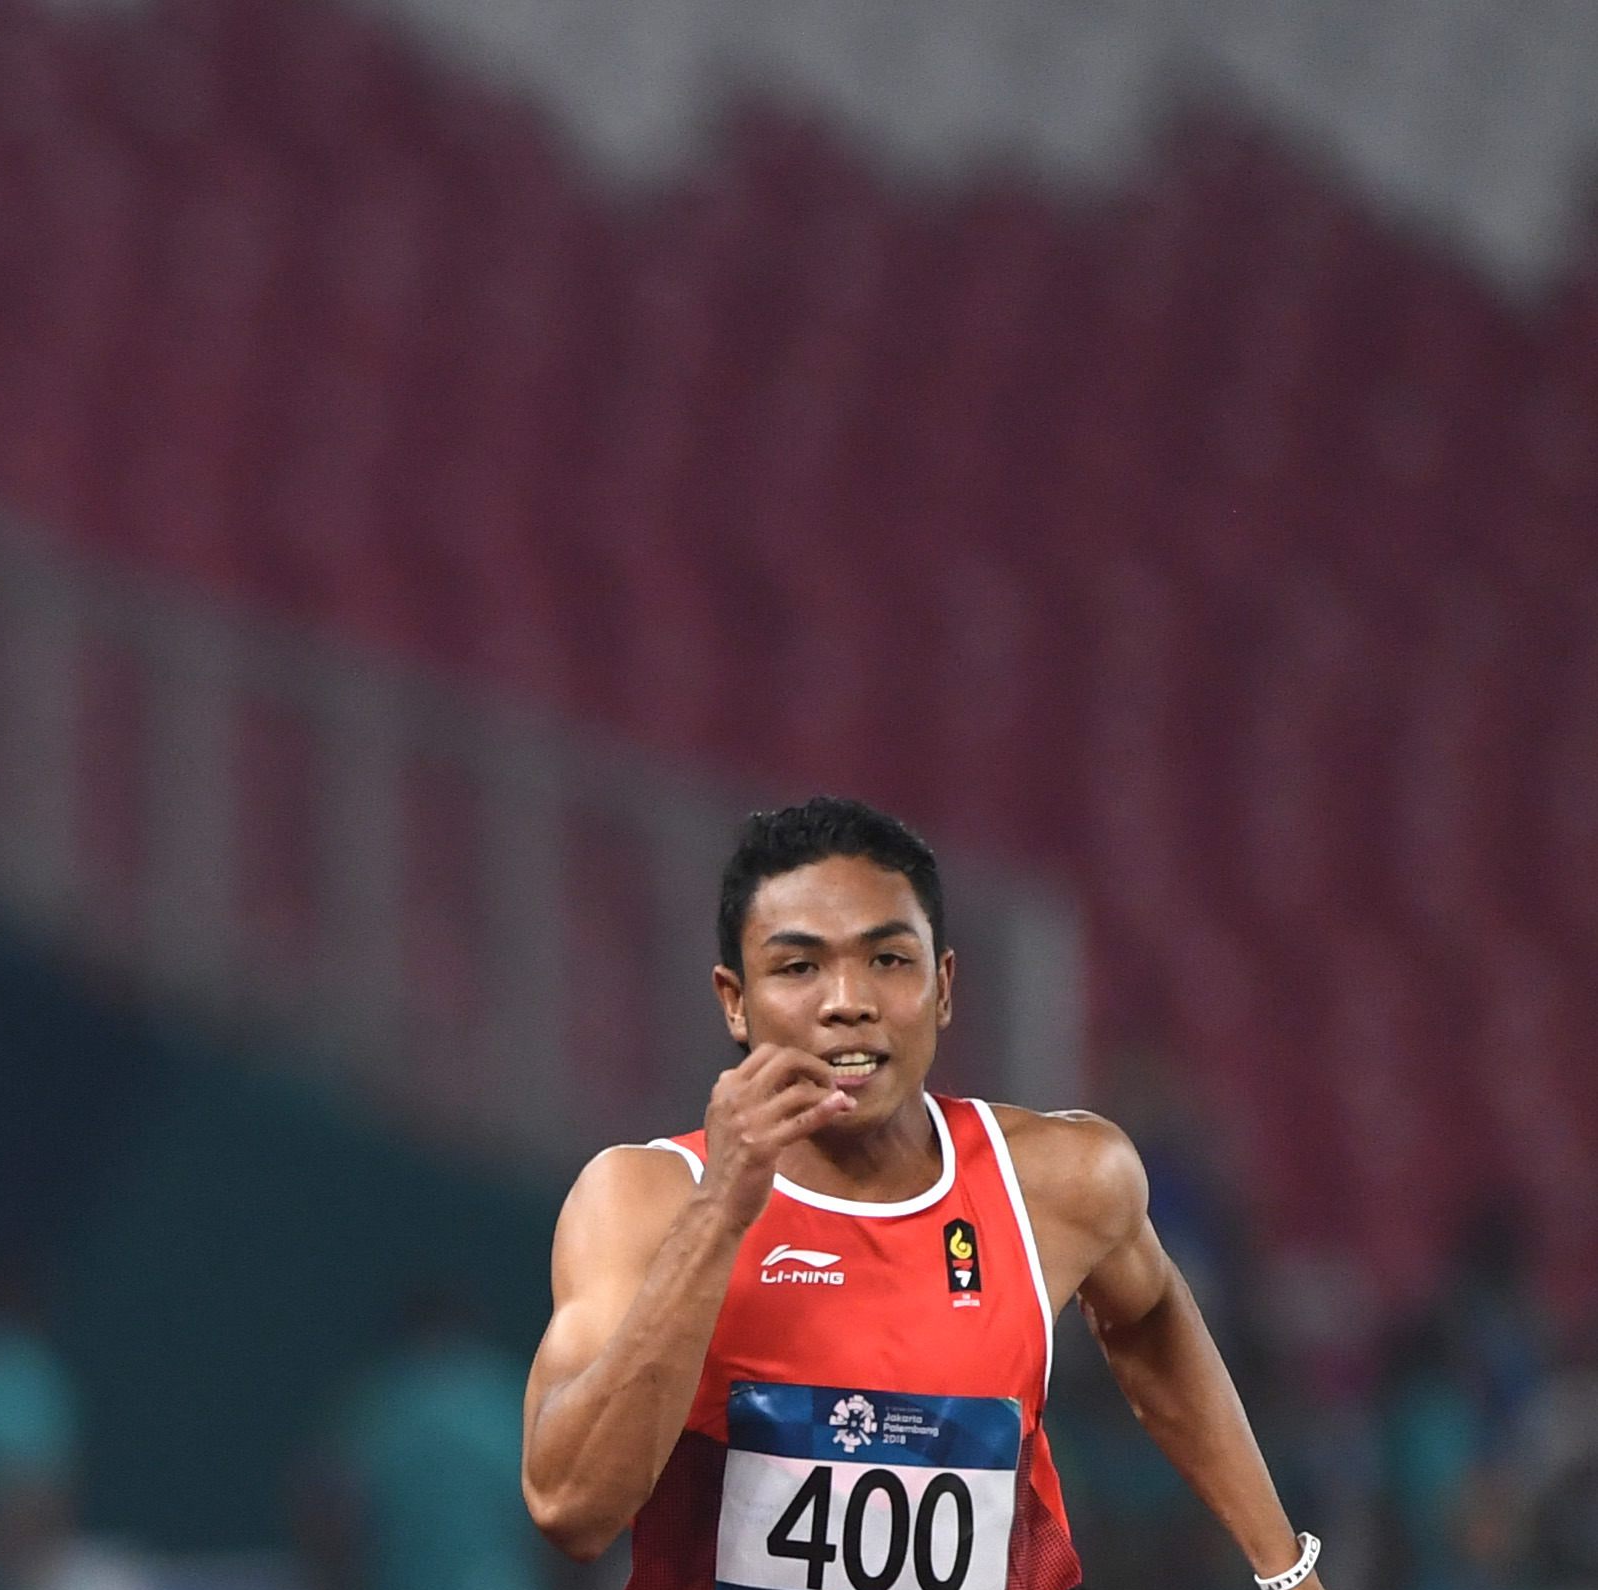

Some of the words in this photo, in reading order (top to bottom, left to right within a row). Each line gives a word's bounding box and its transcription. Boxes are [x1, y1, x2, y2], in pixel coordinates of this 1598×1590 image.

[761, 1270, 845, 1286] LI-NING
[884, 1412, 923, 1424] Jakarta
[883, 1422, 939, 1437] Palembang
[883, 1434, 906, 1445] 2018
